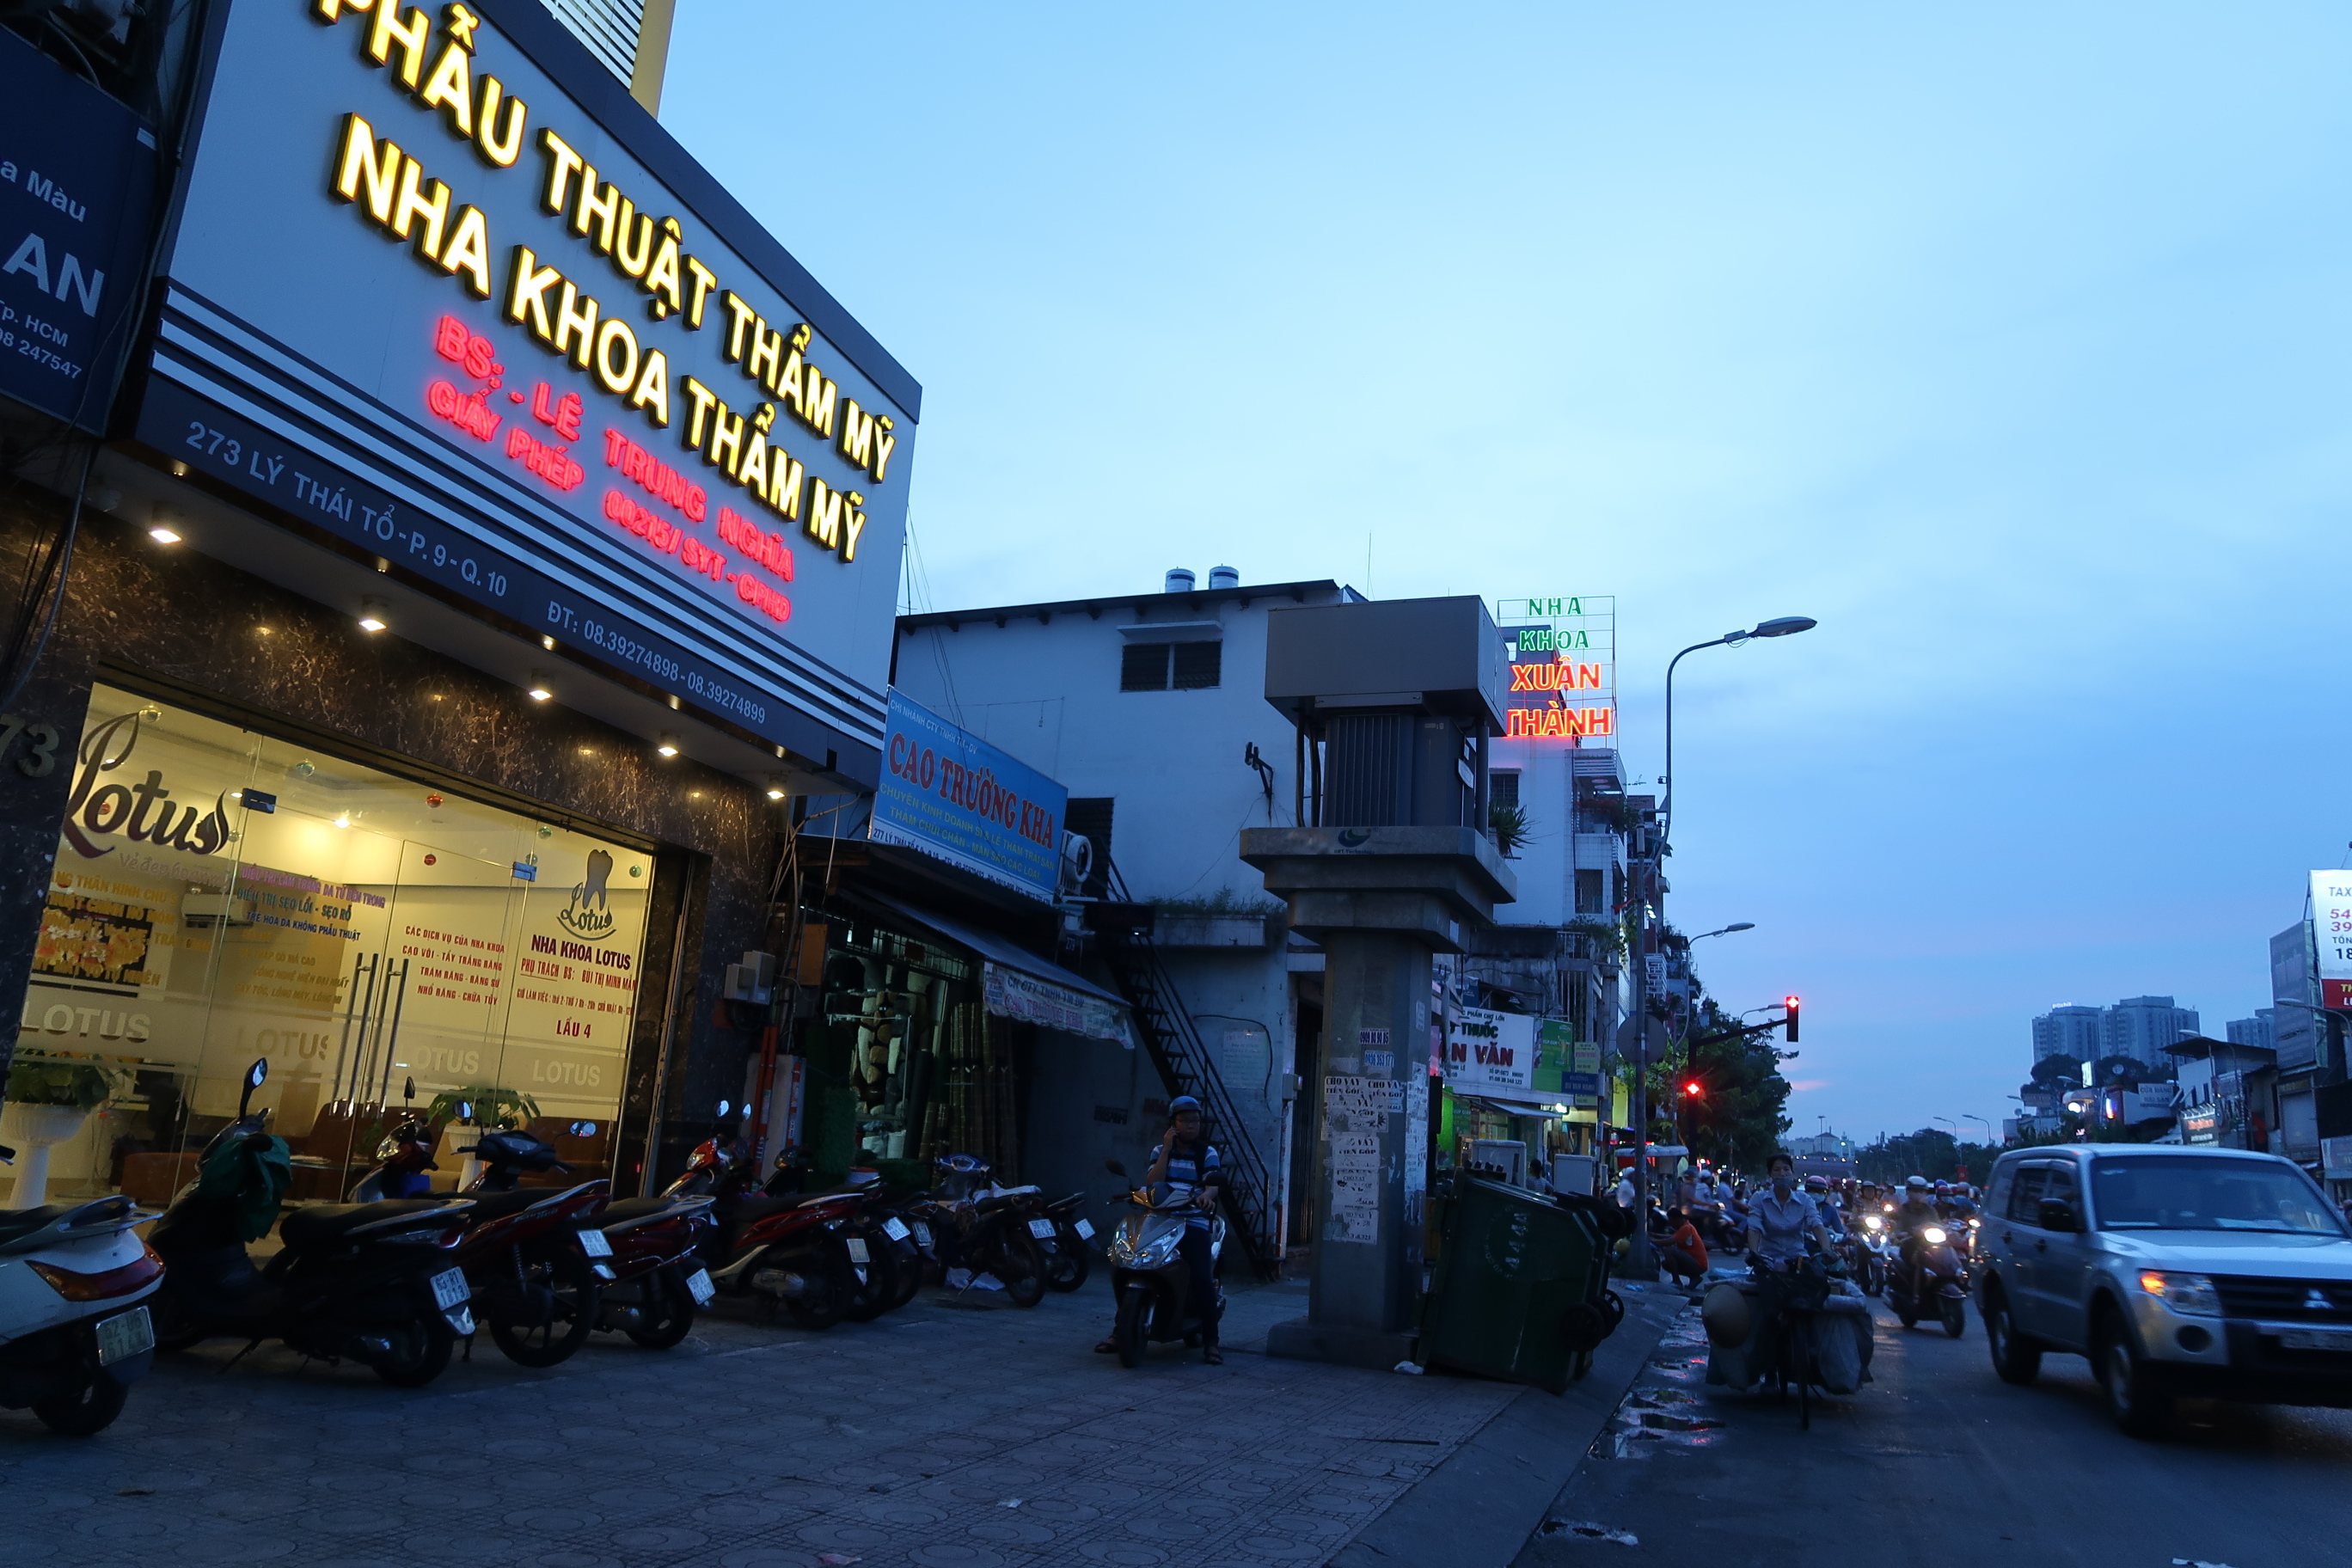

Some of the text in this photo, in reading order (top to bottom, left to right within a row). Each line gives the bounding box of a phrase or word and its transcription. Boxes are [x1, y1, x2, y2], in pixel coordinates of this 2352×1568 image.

[27, 169, 86, 224] Màu
[311, 0, 896, 483] HẪU THUẬT THẨM MỸ
[26, 315, 70, 347] HCM
[331, 112, 866, 564] NHA KHOA THẨM MỸ
[18, 340, 83, 379] 247547
[533, 383, 585, 441] LÊ
[186, 420, 242, 466] 273
[248, 450, 285, 486] LÝ
[293, 471, 353, 523] THÁI
[507, 427, 585, 491] PHÉP
[605, 428, 707, 523] TRUNG
[1528, 596, 1583, 617] NHA
[1519, 629, 1589, 652] KHOA
[1510, 655, 1602, 691] XUÂN
[890, 700, 903, 714] CHI
[903, 706, 926, 726] NHÁNH
[926, 719, 940, 733] CTY
[940, 726, 956, 744] TNHH
[1507, 701, 1612, 737] THÀNH
[63, 712, 230, 859] Lotus
[889, 732, 1054, 850] CAO TRƯỜNG KHA
[879, 782, 919, 809] CHUYÊN
[921, 801, 944, 820] KINH
[944, 812, 973, 833] DOANH
[873, 827, 885, 840] 277
[885, 830, 893, 843] LÝ
[323, 884, 334, 897] DA
[363, 891, 386, 910] TRONG
[280, 918, 291, 928] DA
[405, 925, 421, 937] CÁC
[470, 939, 484, 950] NHA
[487, 942, 505, 953] KHOA
[531, 934, 631, 971] NHA KHOA LOTUS
[537, 960, 560, 978] TRÁCH
[20, 1001, 151, 1041] LOTUS
[584, 1024, 591, 1038] 4
[532, 1058, 601, 1087] LOTUS
[1474, 1041, 1514, 1068] VĂN
[1344, 1077, 1361, 1086] VAY
[1368, 1080, 1385, 1089] CHO
